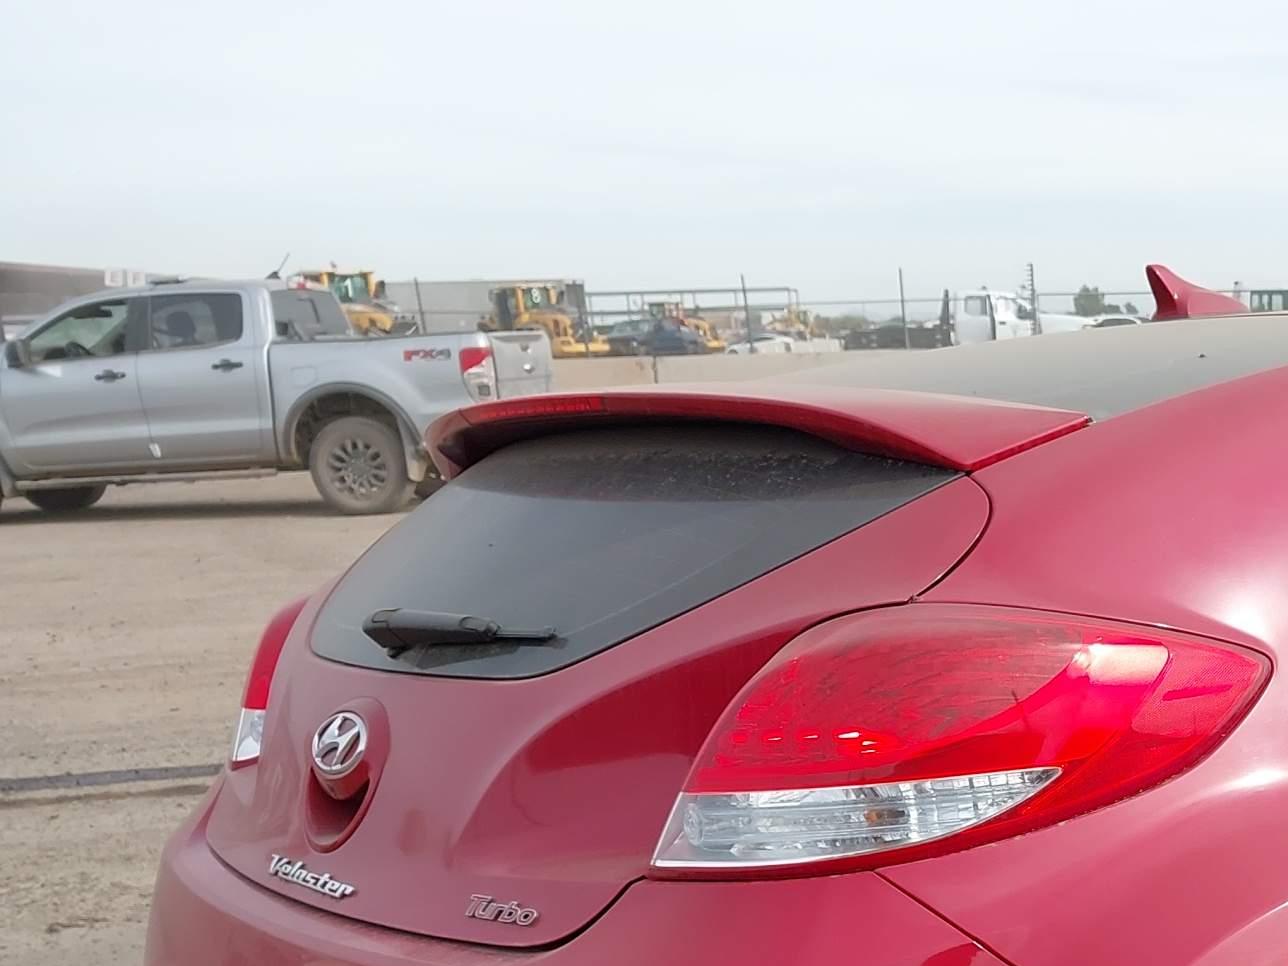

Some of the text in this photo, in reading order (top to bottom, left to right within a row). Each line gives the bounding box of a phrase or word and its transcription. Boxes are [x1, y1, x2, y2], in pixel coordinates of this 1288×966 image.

[531, 288, 541, 304] 8
[403, 348, 452, 361] FX4
[270, 853, 355, 898] Veloster
[465, 894, 538, 926] Turbo
